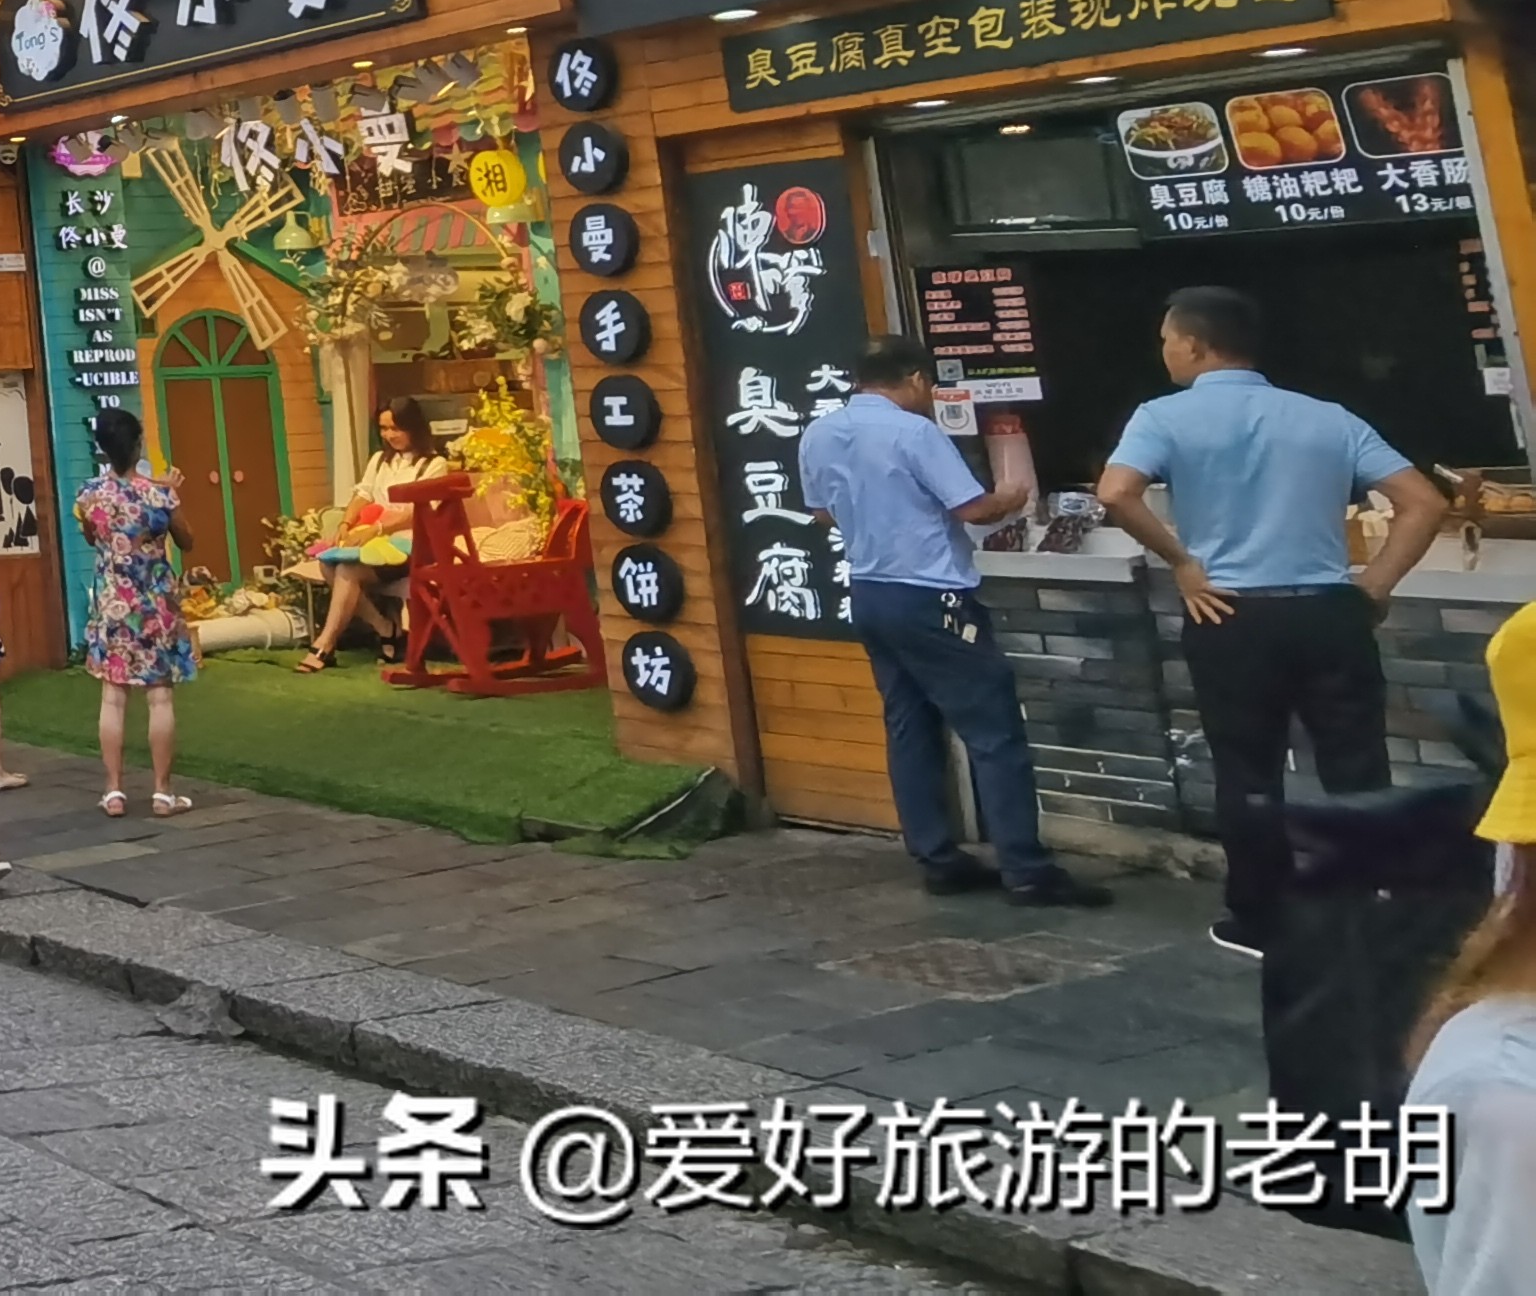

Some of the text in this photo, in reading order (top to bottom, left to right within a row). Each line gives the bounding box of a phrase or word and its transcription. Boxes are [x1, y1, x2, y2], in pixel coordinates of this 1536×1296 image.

[1241, 167, 1364, 204] 糖油粑粑
[1376, 156, 1470, 192] 大香肠
[66, 189, 115, 215] 长沙
[1149, 178, 1230, 211] 臭豆腐
[87, 256, 106, 278] @
[80, 286, 120, 302] MISS
[91, 329, 113, 344] AS
[73, 348, 136, 365] REPROD
[555, 50, 672, 697] 佟小曼手工茶饼坊
[97, 394, 121, 409] TO
[726, 366, 822, 621] 臭豆腐
